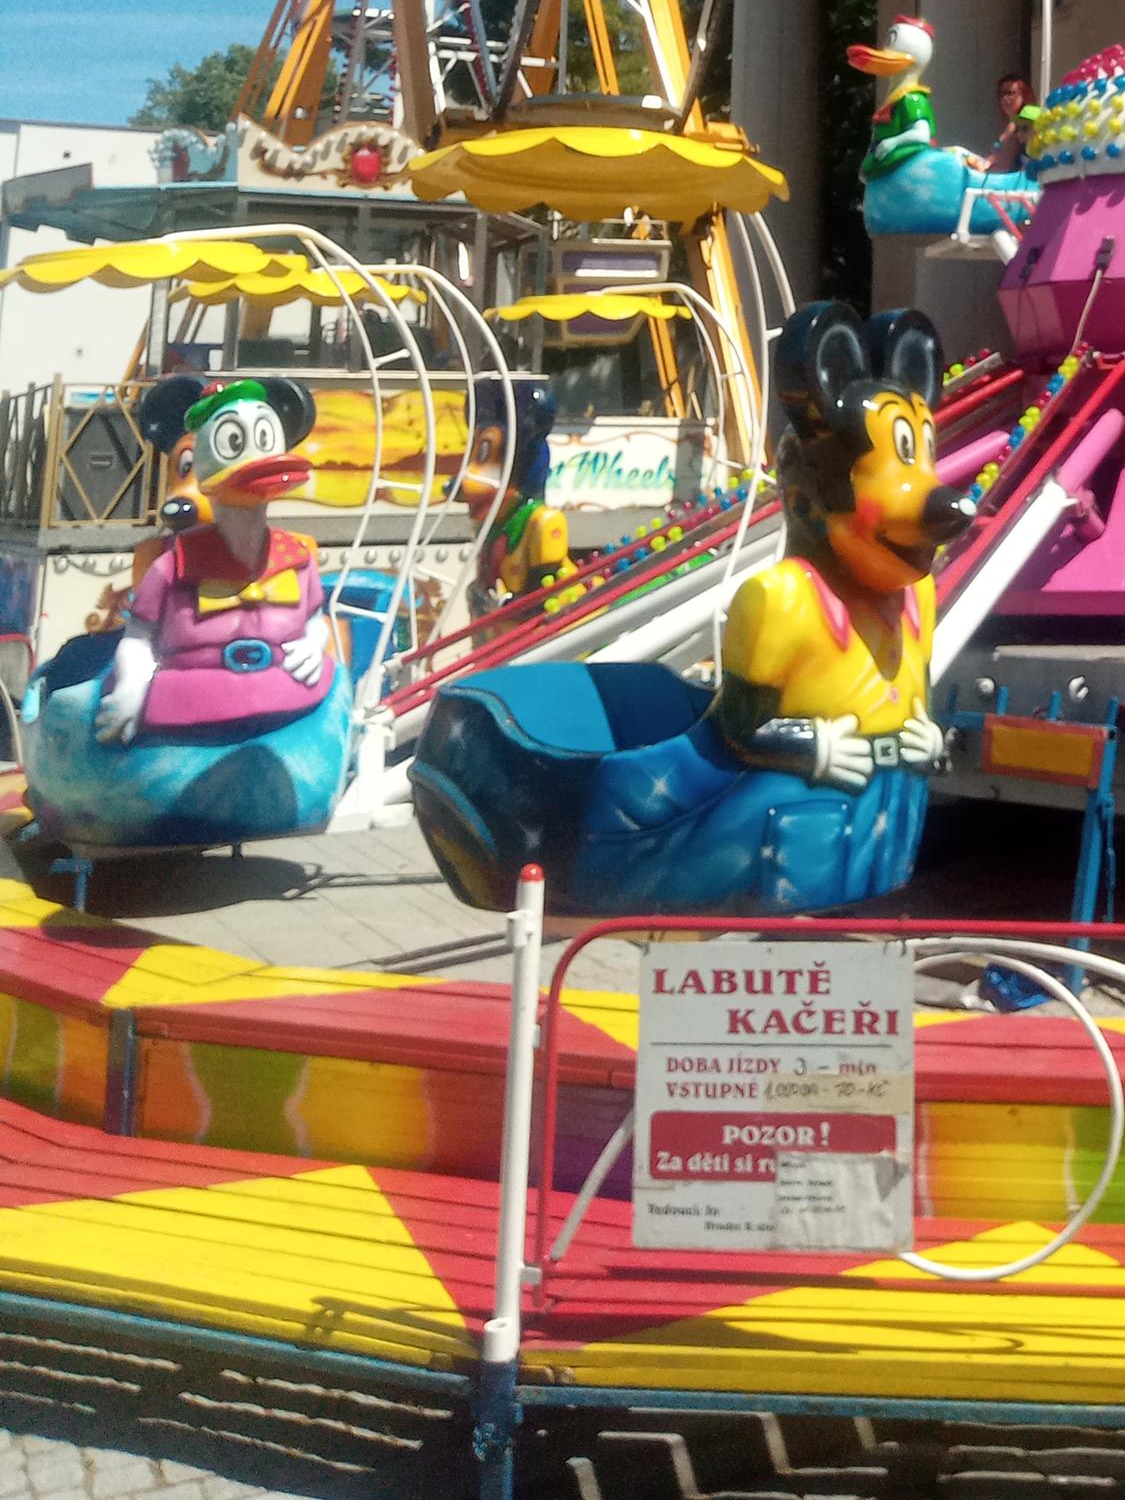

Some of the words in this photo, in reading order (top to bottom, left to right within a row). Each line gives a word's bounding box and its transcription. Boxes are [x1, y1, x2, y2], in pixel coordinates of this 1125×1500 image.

[566, 449, 677, 491] Wheels
[652, 960, 832, 996] LABUTĚ
[726, 1000, 900, 1037] KAČEŘI
[664, 1056, 721, 1074] DOBA
[727, 1052, 781, 1074] JÍZDY
[838, 1059, 878, 1075] min
[665, 1076, 760, 1099] VSTUPNÉ
[656, 1150, 683, 1171] Za
[687, 1150, 729, 1173] děti
[733, 1152, 753, 1173] si
